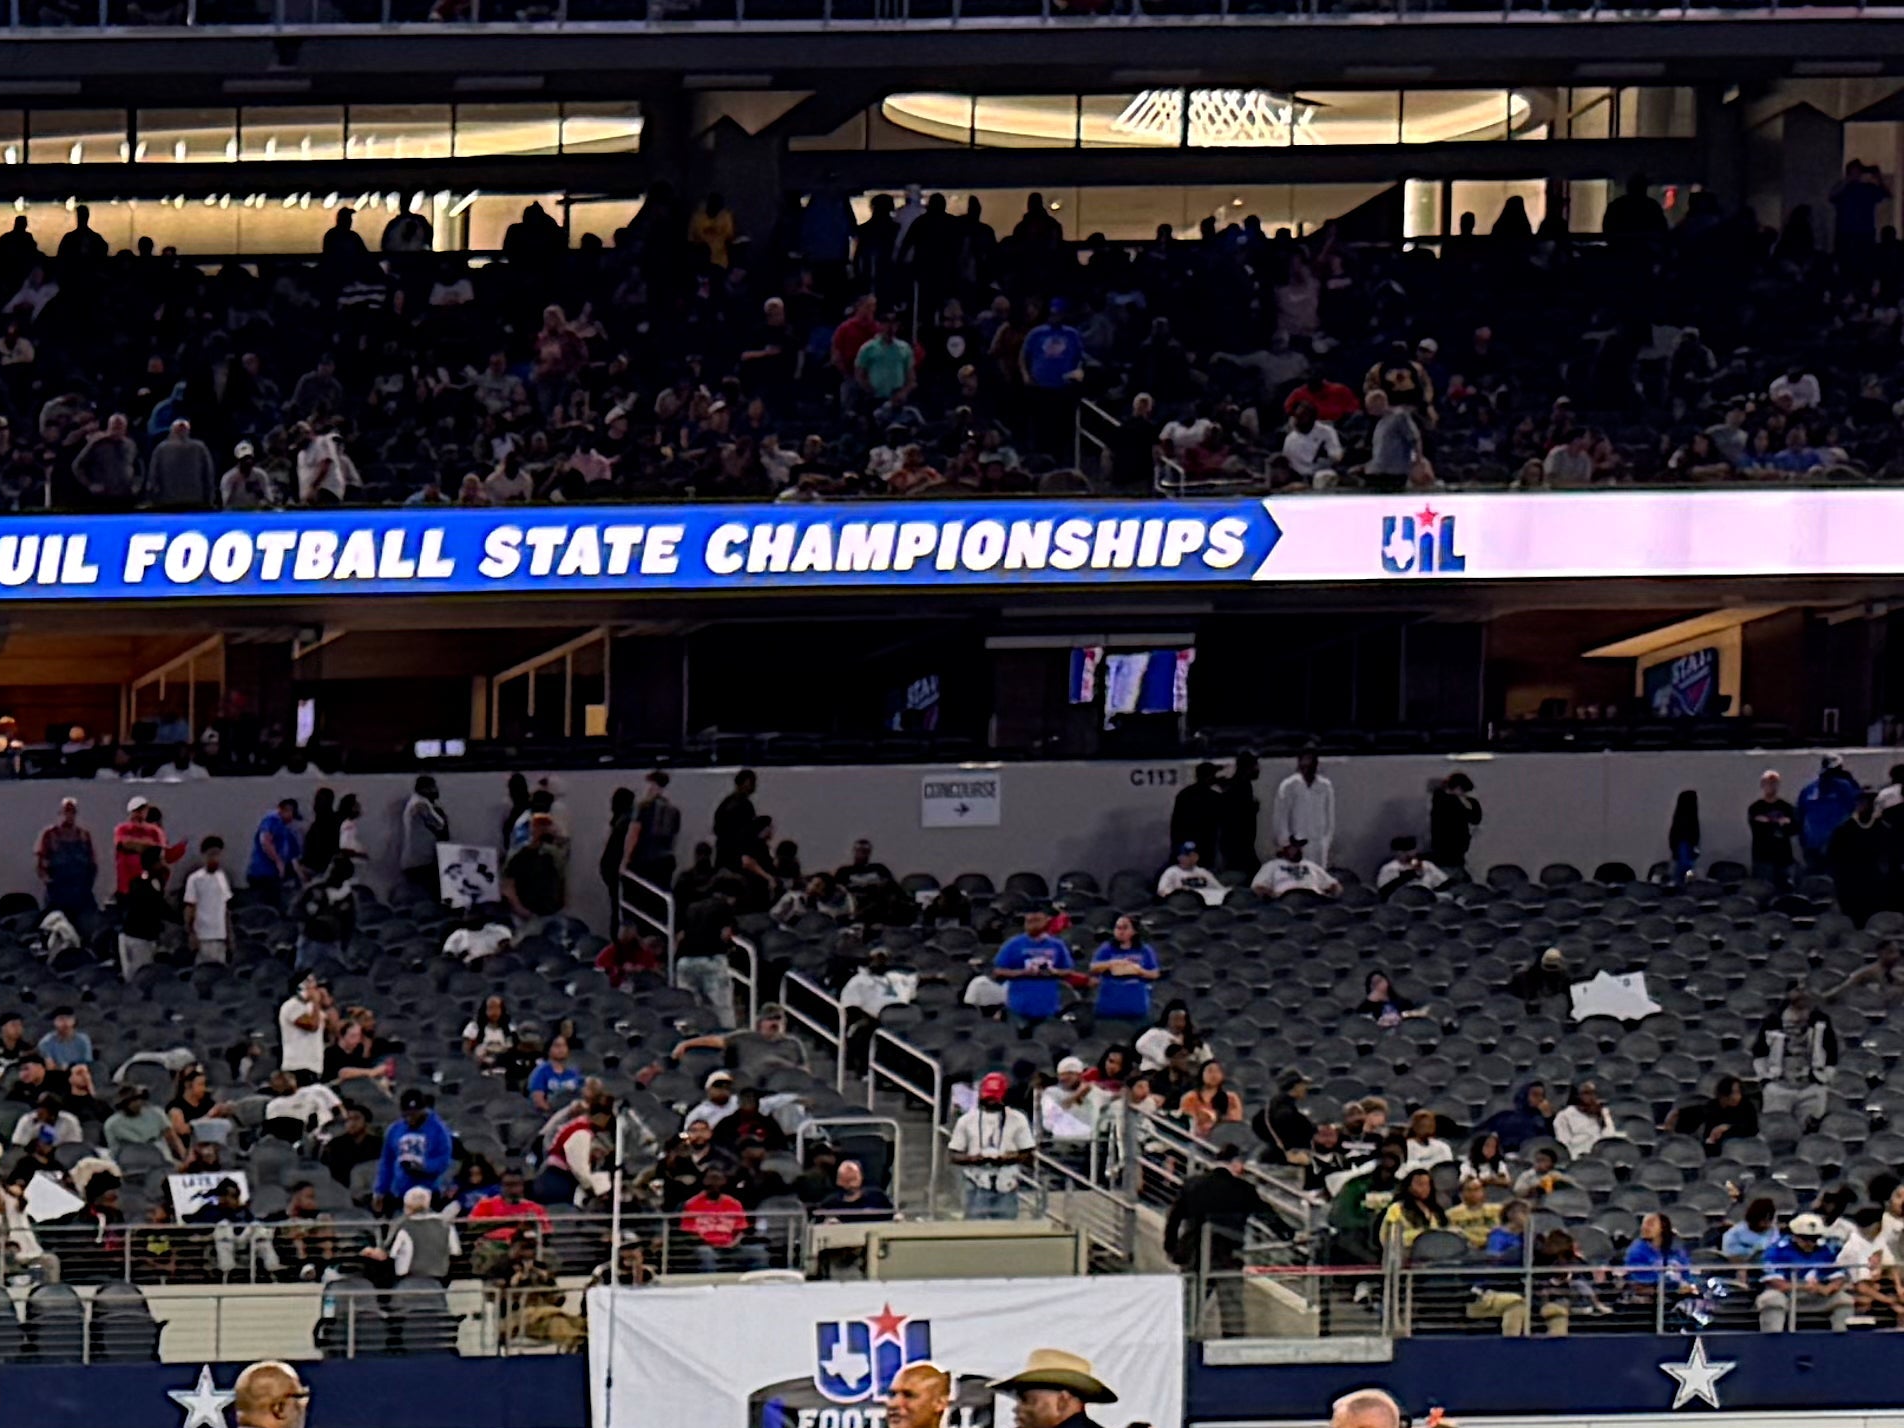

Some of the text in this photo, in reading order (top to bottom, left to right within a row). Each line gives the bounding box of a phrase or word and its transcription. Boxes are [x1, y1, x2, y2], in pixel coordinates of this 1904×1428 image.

[123, 528, 456, 585] FOOTBALL
[477, 523, 685, 579] STATE
[703, 516, 1250, 577] CHAMPIONSHIPS
[1381, 503, 1467, 574] UIL
